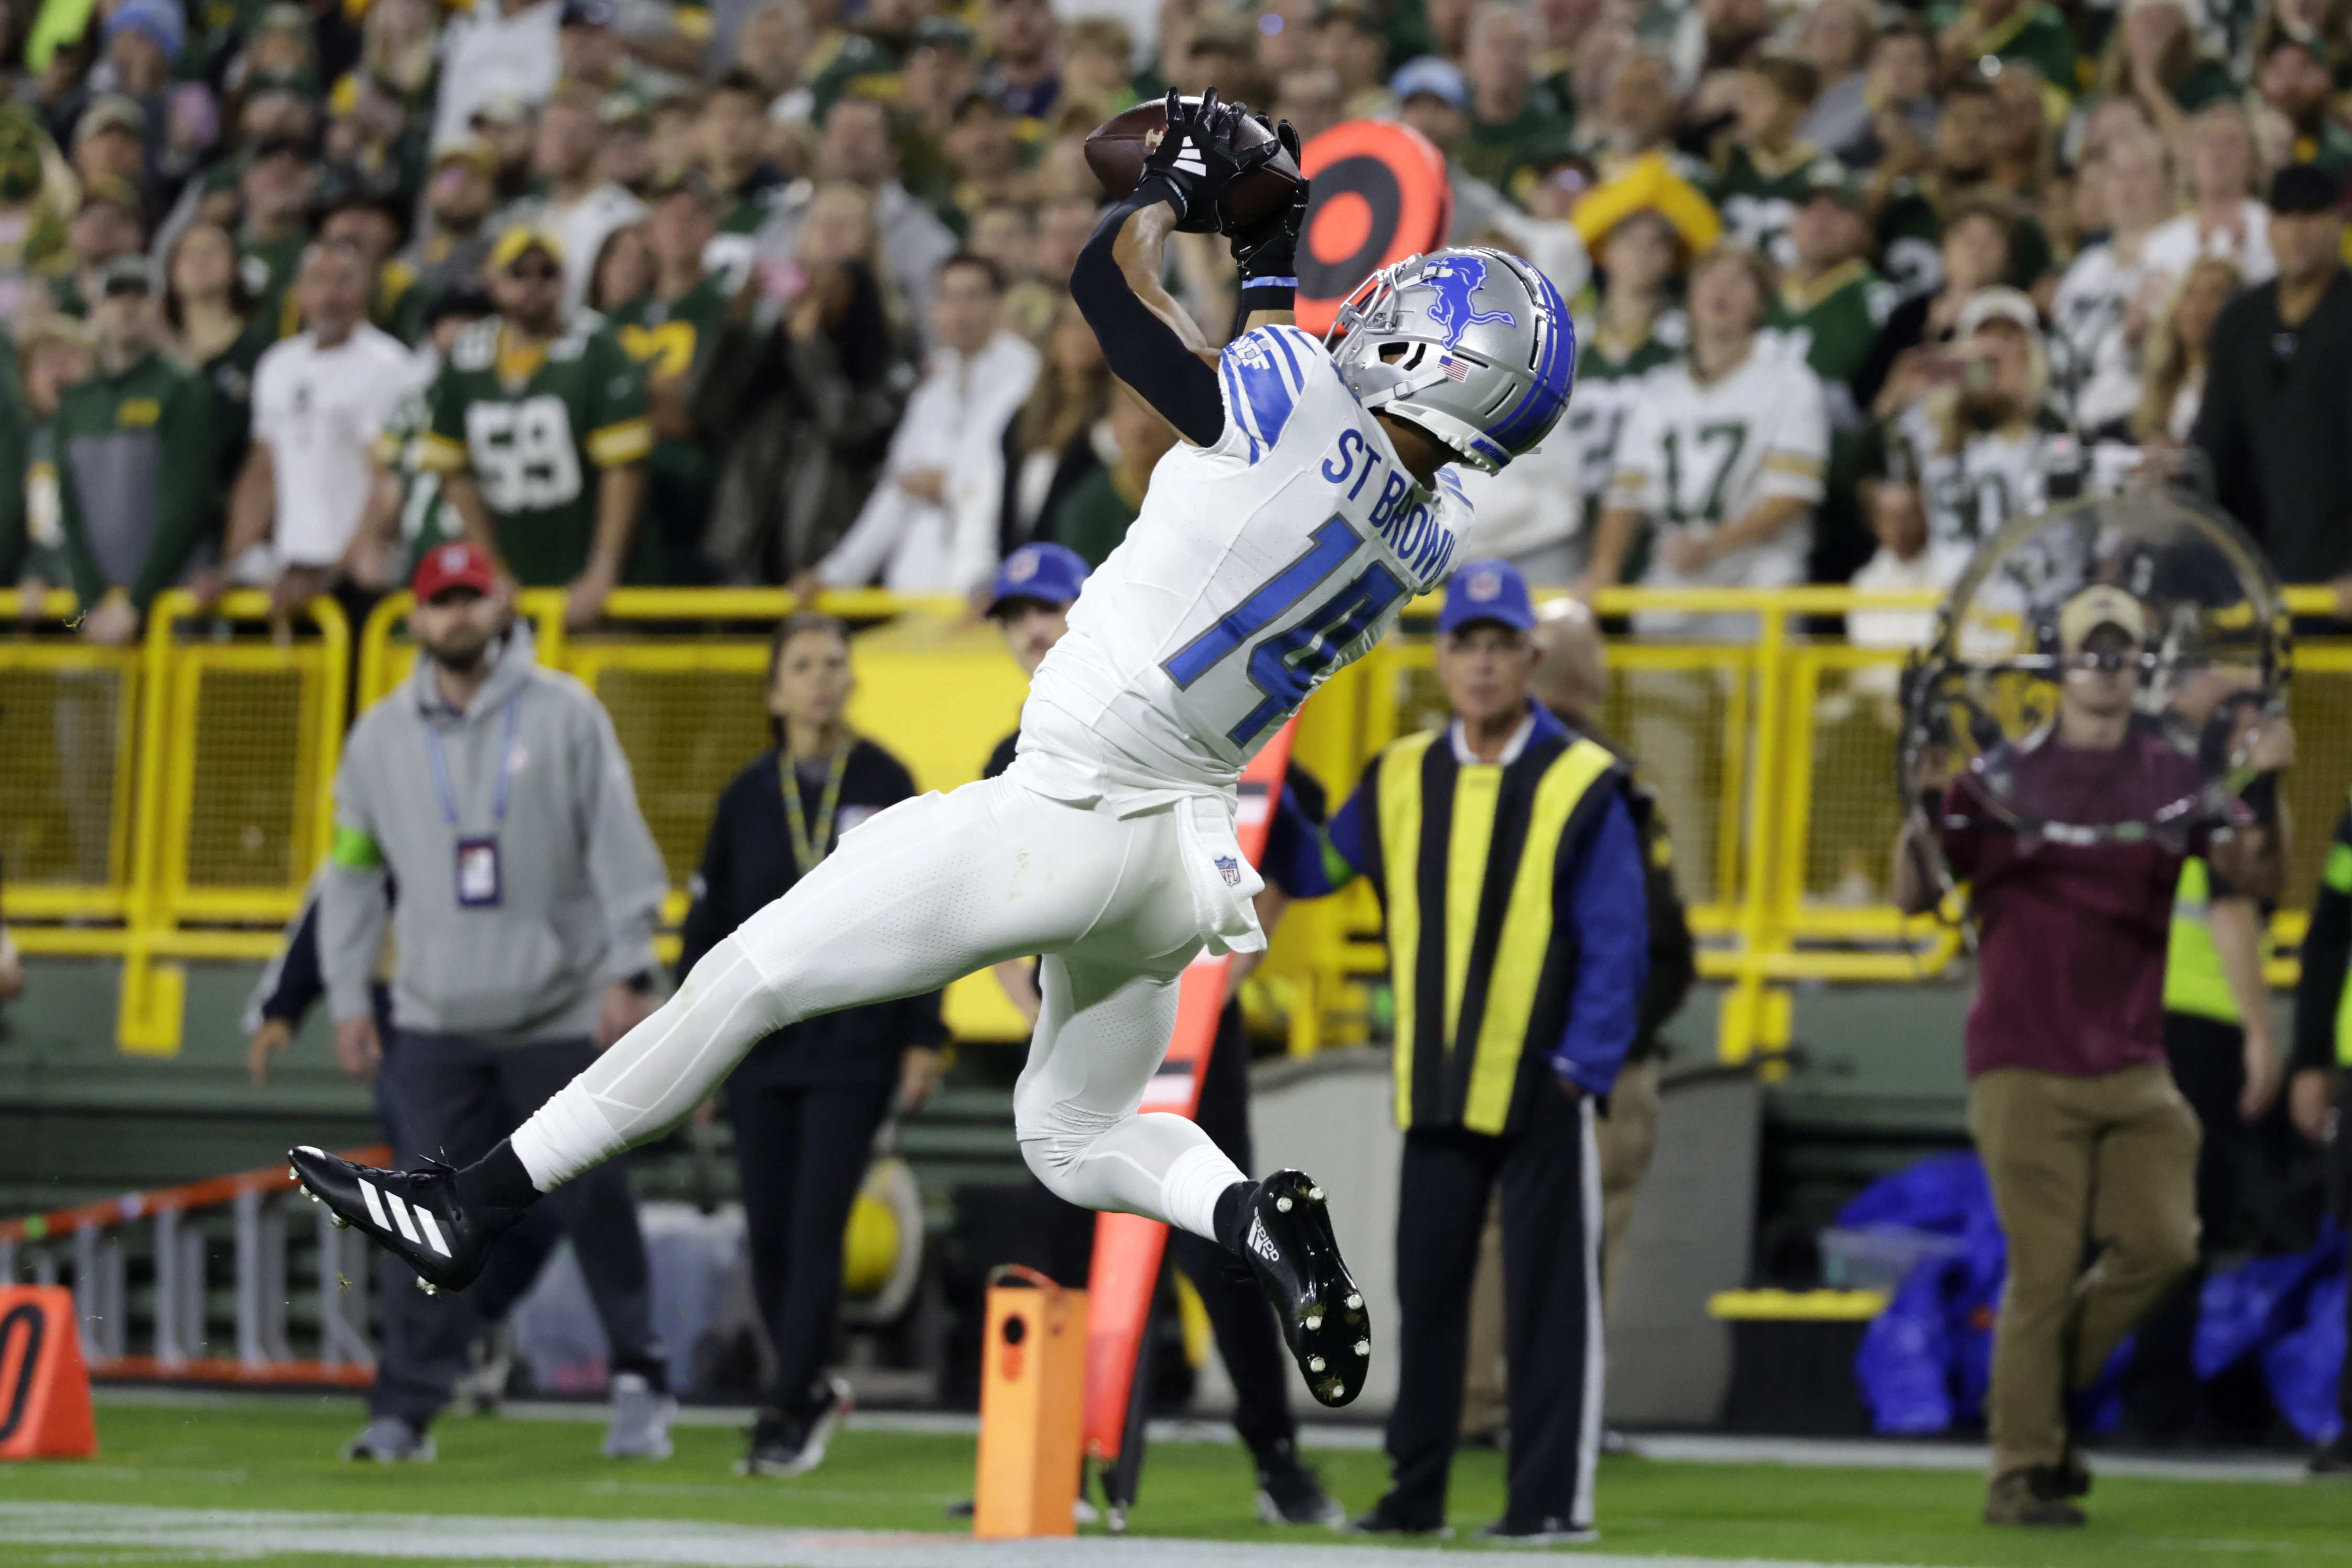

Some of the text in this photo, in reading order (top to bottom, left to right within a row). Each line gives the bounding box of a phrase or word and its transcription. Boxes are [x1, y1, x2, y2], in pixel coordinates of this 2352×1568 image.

[1322, 428, 1382, 503] ST
[1662, 421, 1747, 523] 17
[1159, 512, 1407, 748] 14
